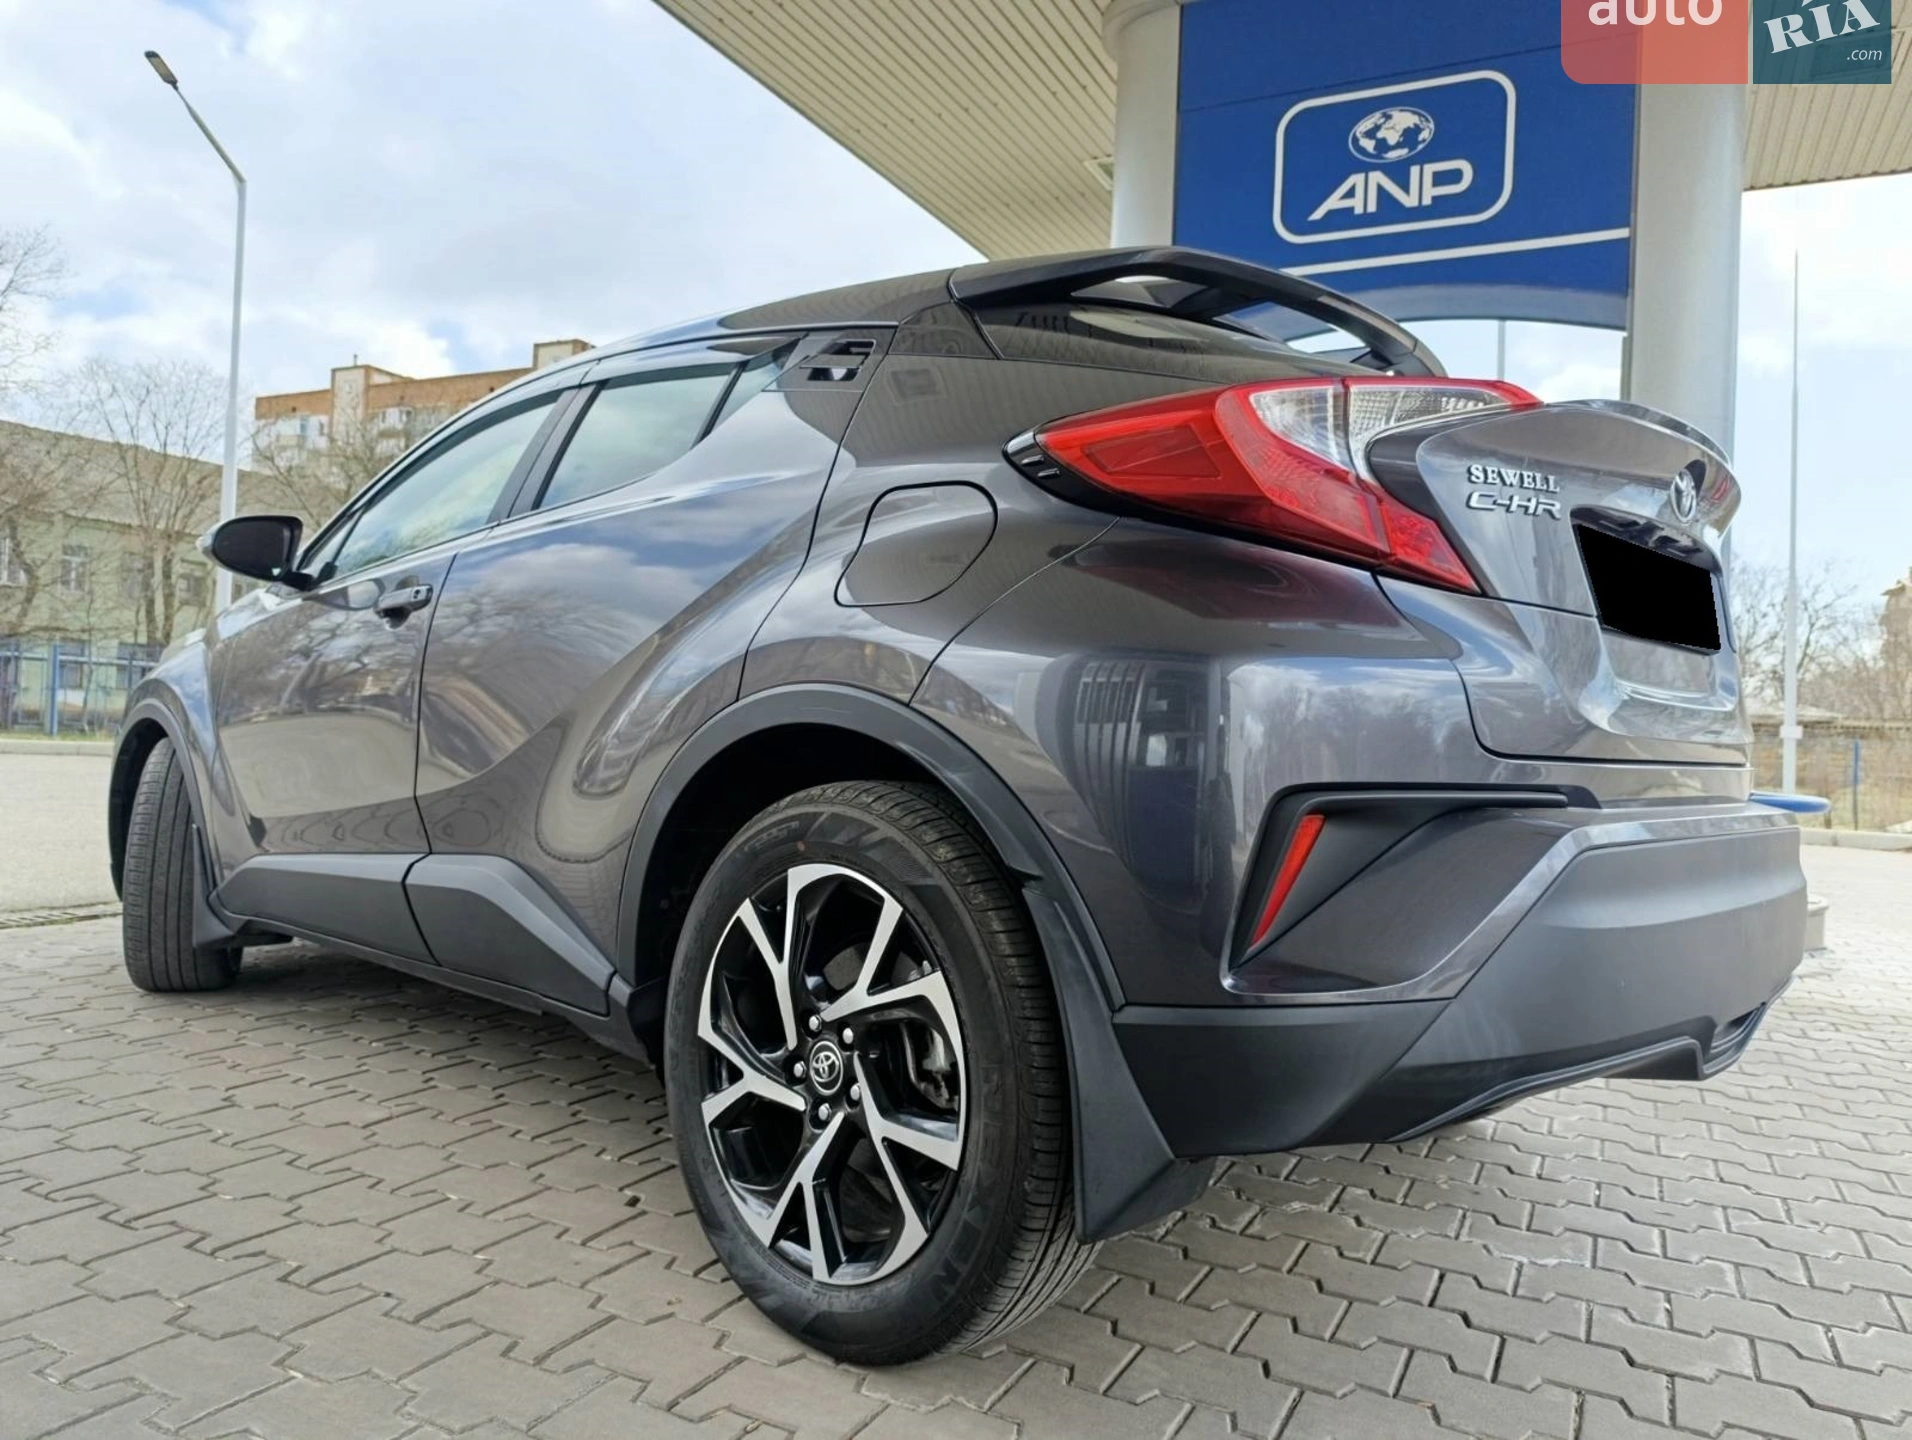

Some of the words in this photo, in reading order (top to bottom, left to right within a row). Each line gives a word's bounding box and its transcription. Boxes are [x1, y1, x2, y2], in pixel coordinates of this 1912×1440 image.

[1307, 158, 1474, 222] ANP
[1467, 463, 1561, 495] SEWELL
[1465, 490, 1562, 521] C-HR
